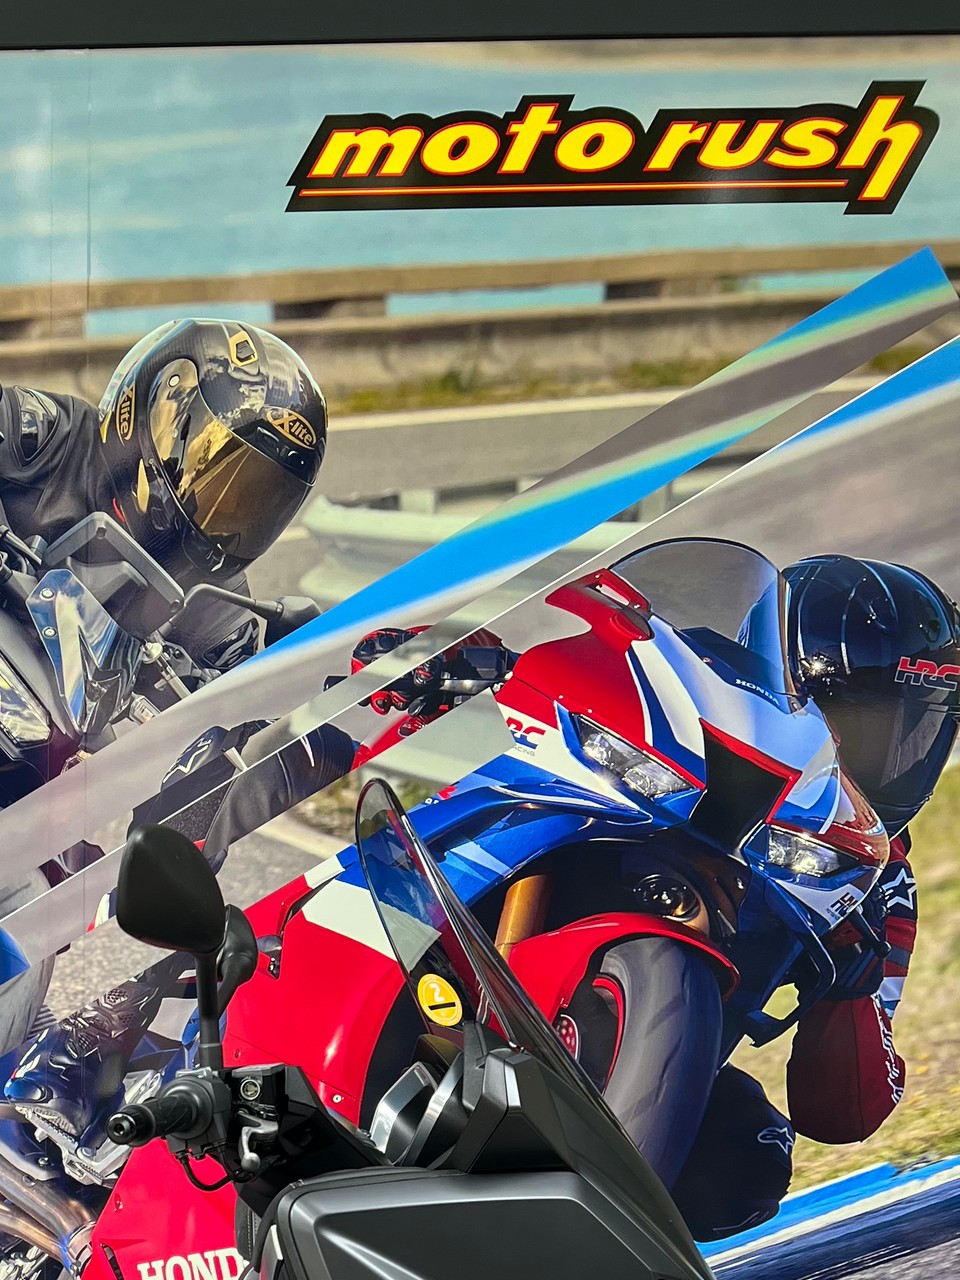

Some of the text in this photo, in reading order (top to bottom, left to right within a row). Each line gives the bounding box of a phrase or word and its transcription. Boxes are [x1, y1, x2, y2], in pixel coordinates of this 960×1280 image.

[307, 96, 922, 200] moto rush
[120, 385, 136, 435] X-lite
[270, 408, 313, 446] X-lite
[735, 678, 780, 706] HONDA
[894, 656, 960, 692] HRC
[505, 716, 547, 750] RC
